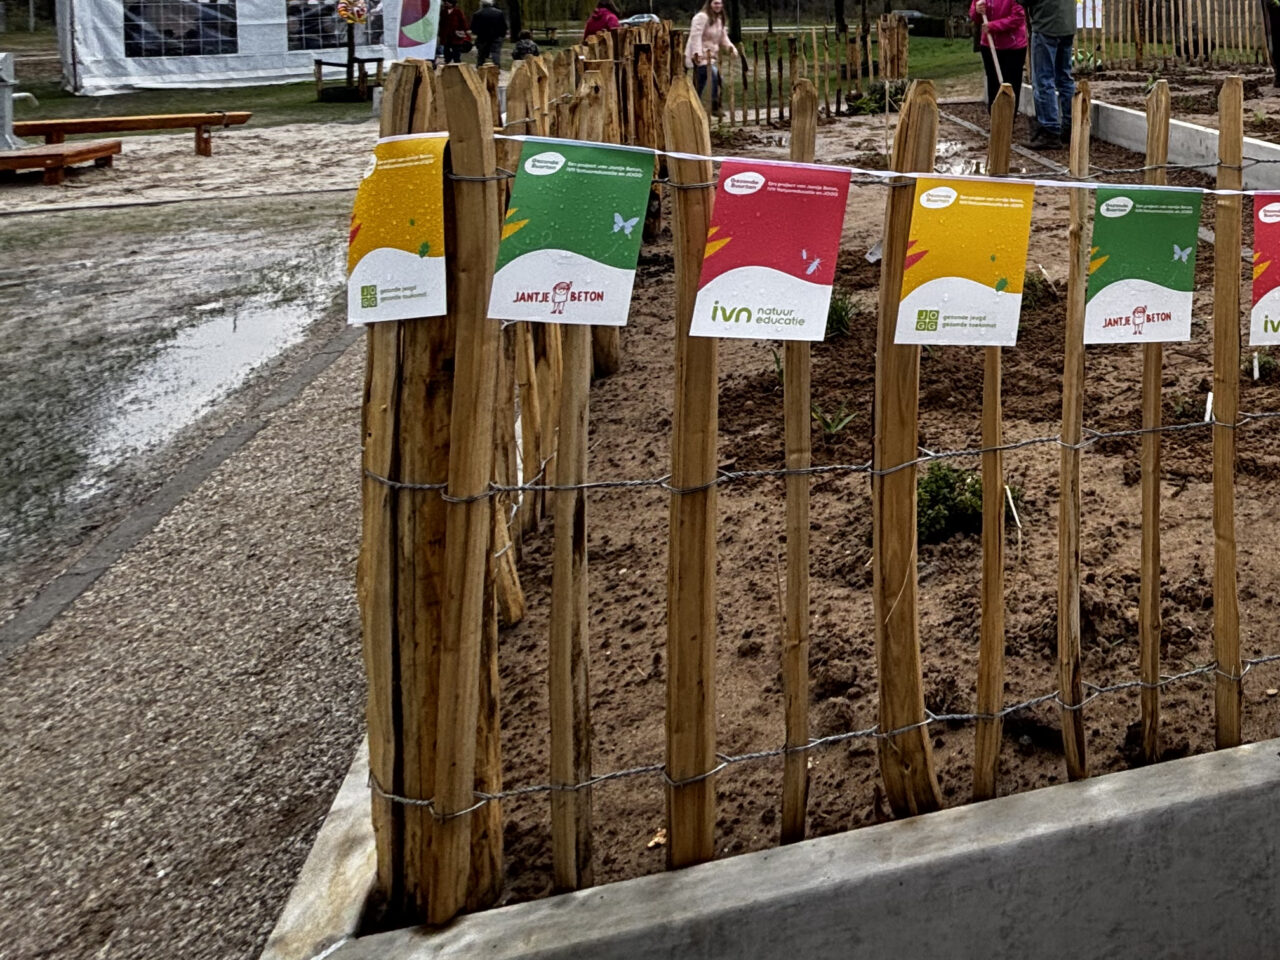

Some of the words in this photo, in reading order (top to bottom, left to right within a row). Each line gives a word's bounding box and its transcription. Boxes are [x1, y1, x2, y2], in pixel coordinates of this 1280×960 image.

[513, 291, 550, 303] JANTJE
[570, 290, 604, 301] BETON
[711, 300, 752, 323] ivn
[757, 307, 794, 316] natuur
[756, 315, 805, 326] educatie
[1103, 316, 1131, 328] JANTJE
[1146, 312, 1172, 323] BETON
